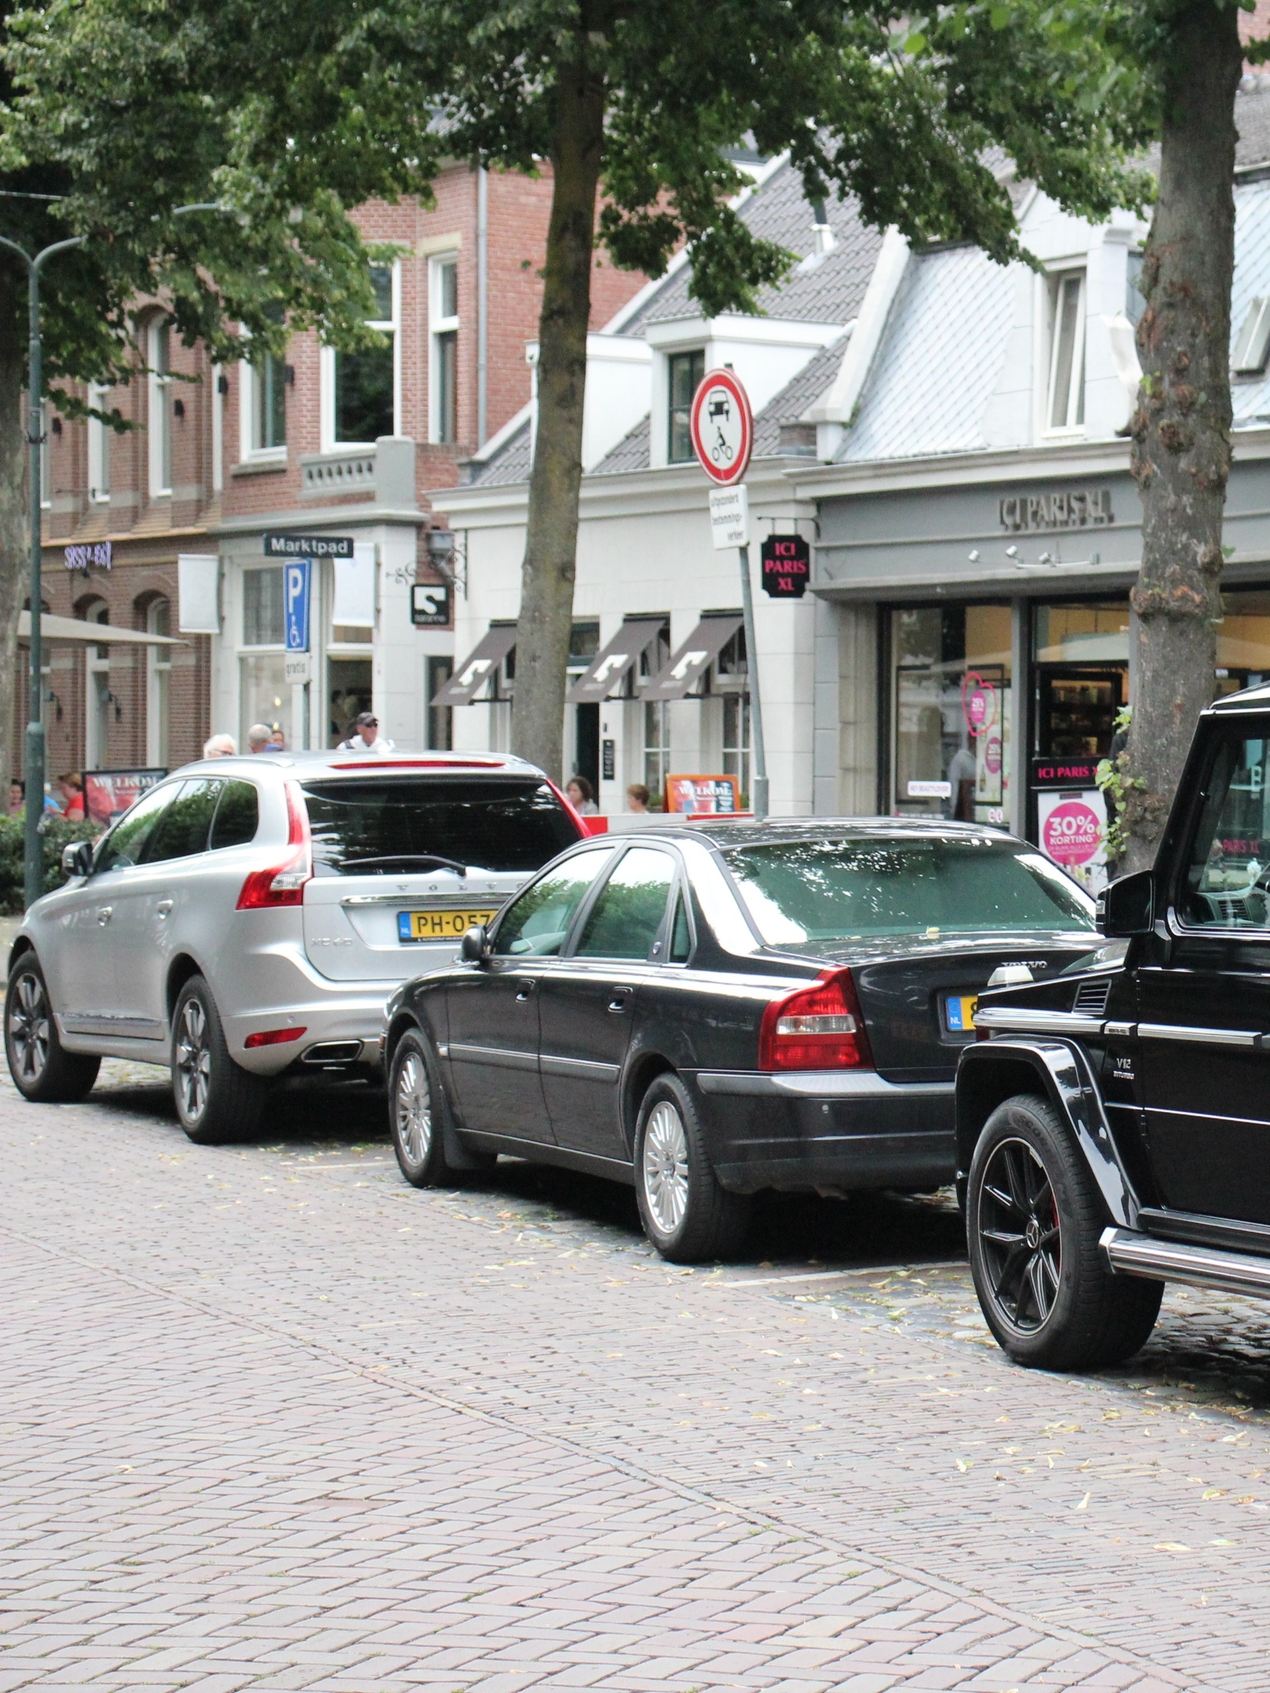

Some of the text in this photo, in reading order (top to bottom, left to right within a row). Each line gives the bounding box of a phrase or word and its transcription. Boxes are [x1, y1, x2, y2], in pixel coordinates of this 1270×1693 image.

[271, 537, 348, 554] Marktpad
[774, 542, 797, 556] ICI
[764, 559, 807, 574] PARIS
[288, 568, 302, 614] P
[778, 577, 795, 591] XL
[1038, 767, 1054, 778] ICI
[1057, 766, 1089, 777] PARIS
[1049, 815, 1095, 836] 30%
[1116, 1058, 1131, 1069] V12
